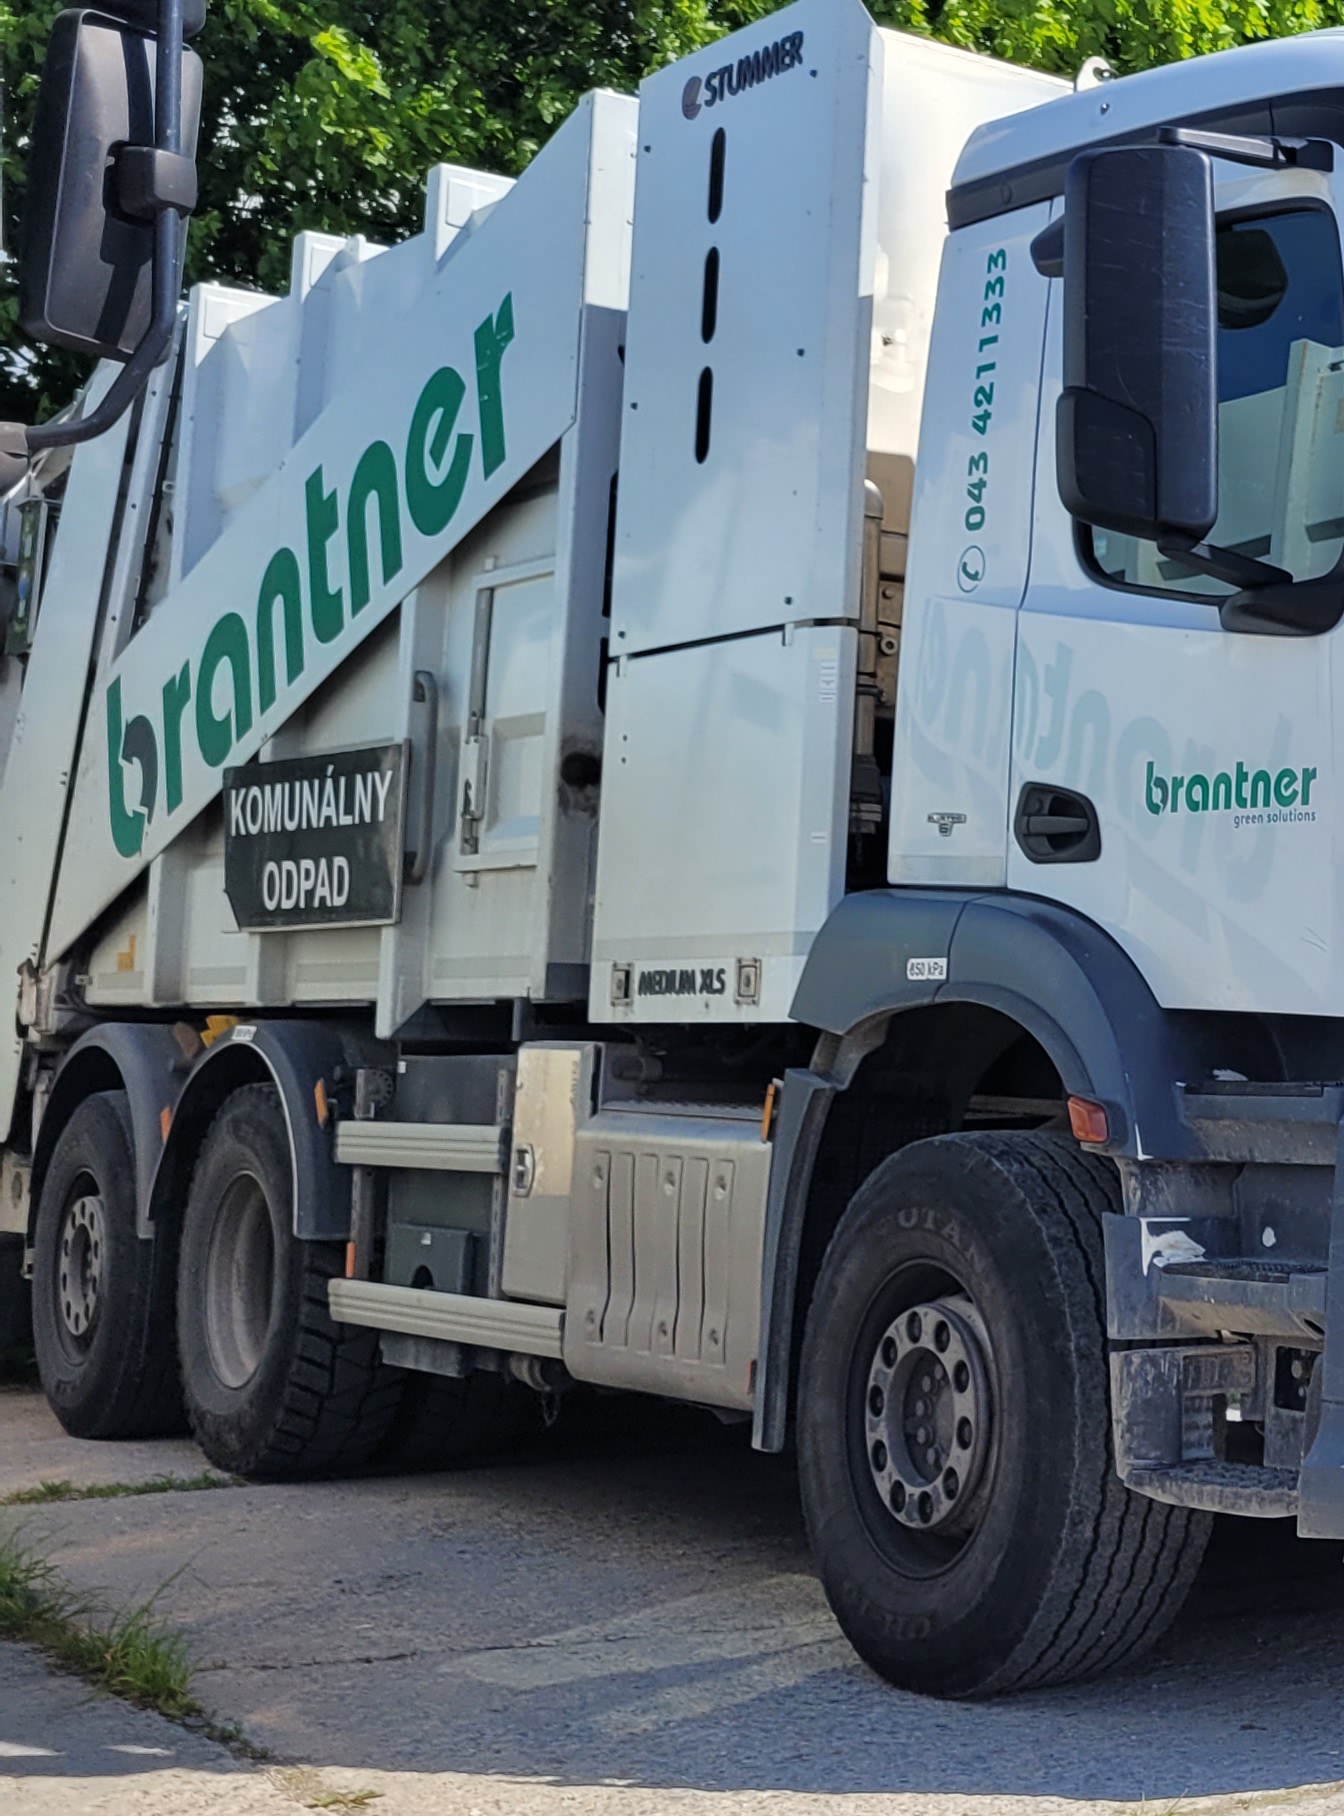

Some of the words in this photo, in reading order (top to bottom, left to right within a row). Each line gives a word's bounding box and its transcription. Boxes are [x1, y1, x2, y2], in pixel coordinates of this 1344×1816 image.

[704, 31, 803, 107] STUMMER
[965, 451, 989, 532] 043
[107, 291, 515, 857] brantner
[230, 764, 393, 837] KOMUNÁLNY
[1145, 761, 1318, 816] brantner
[1234, 813, 1264, 829] green
[1266, 808, 1317, 825] solutions
[262, 855, 350, 911] ODPAD
[638, 969, 698, 996] MEDIUM
[699, 968, 726, 995] XLS
